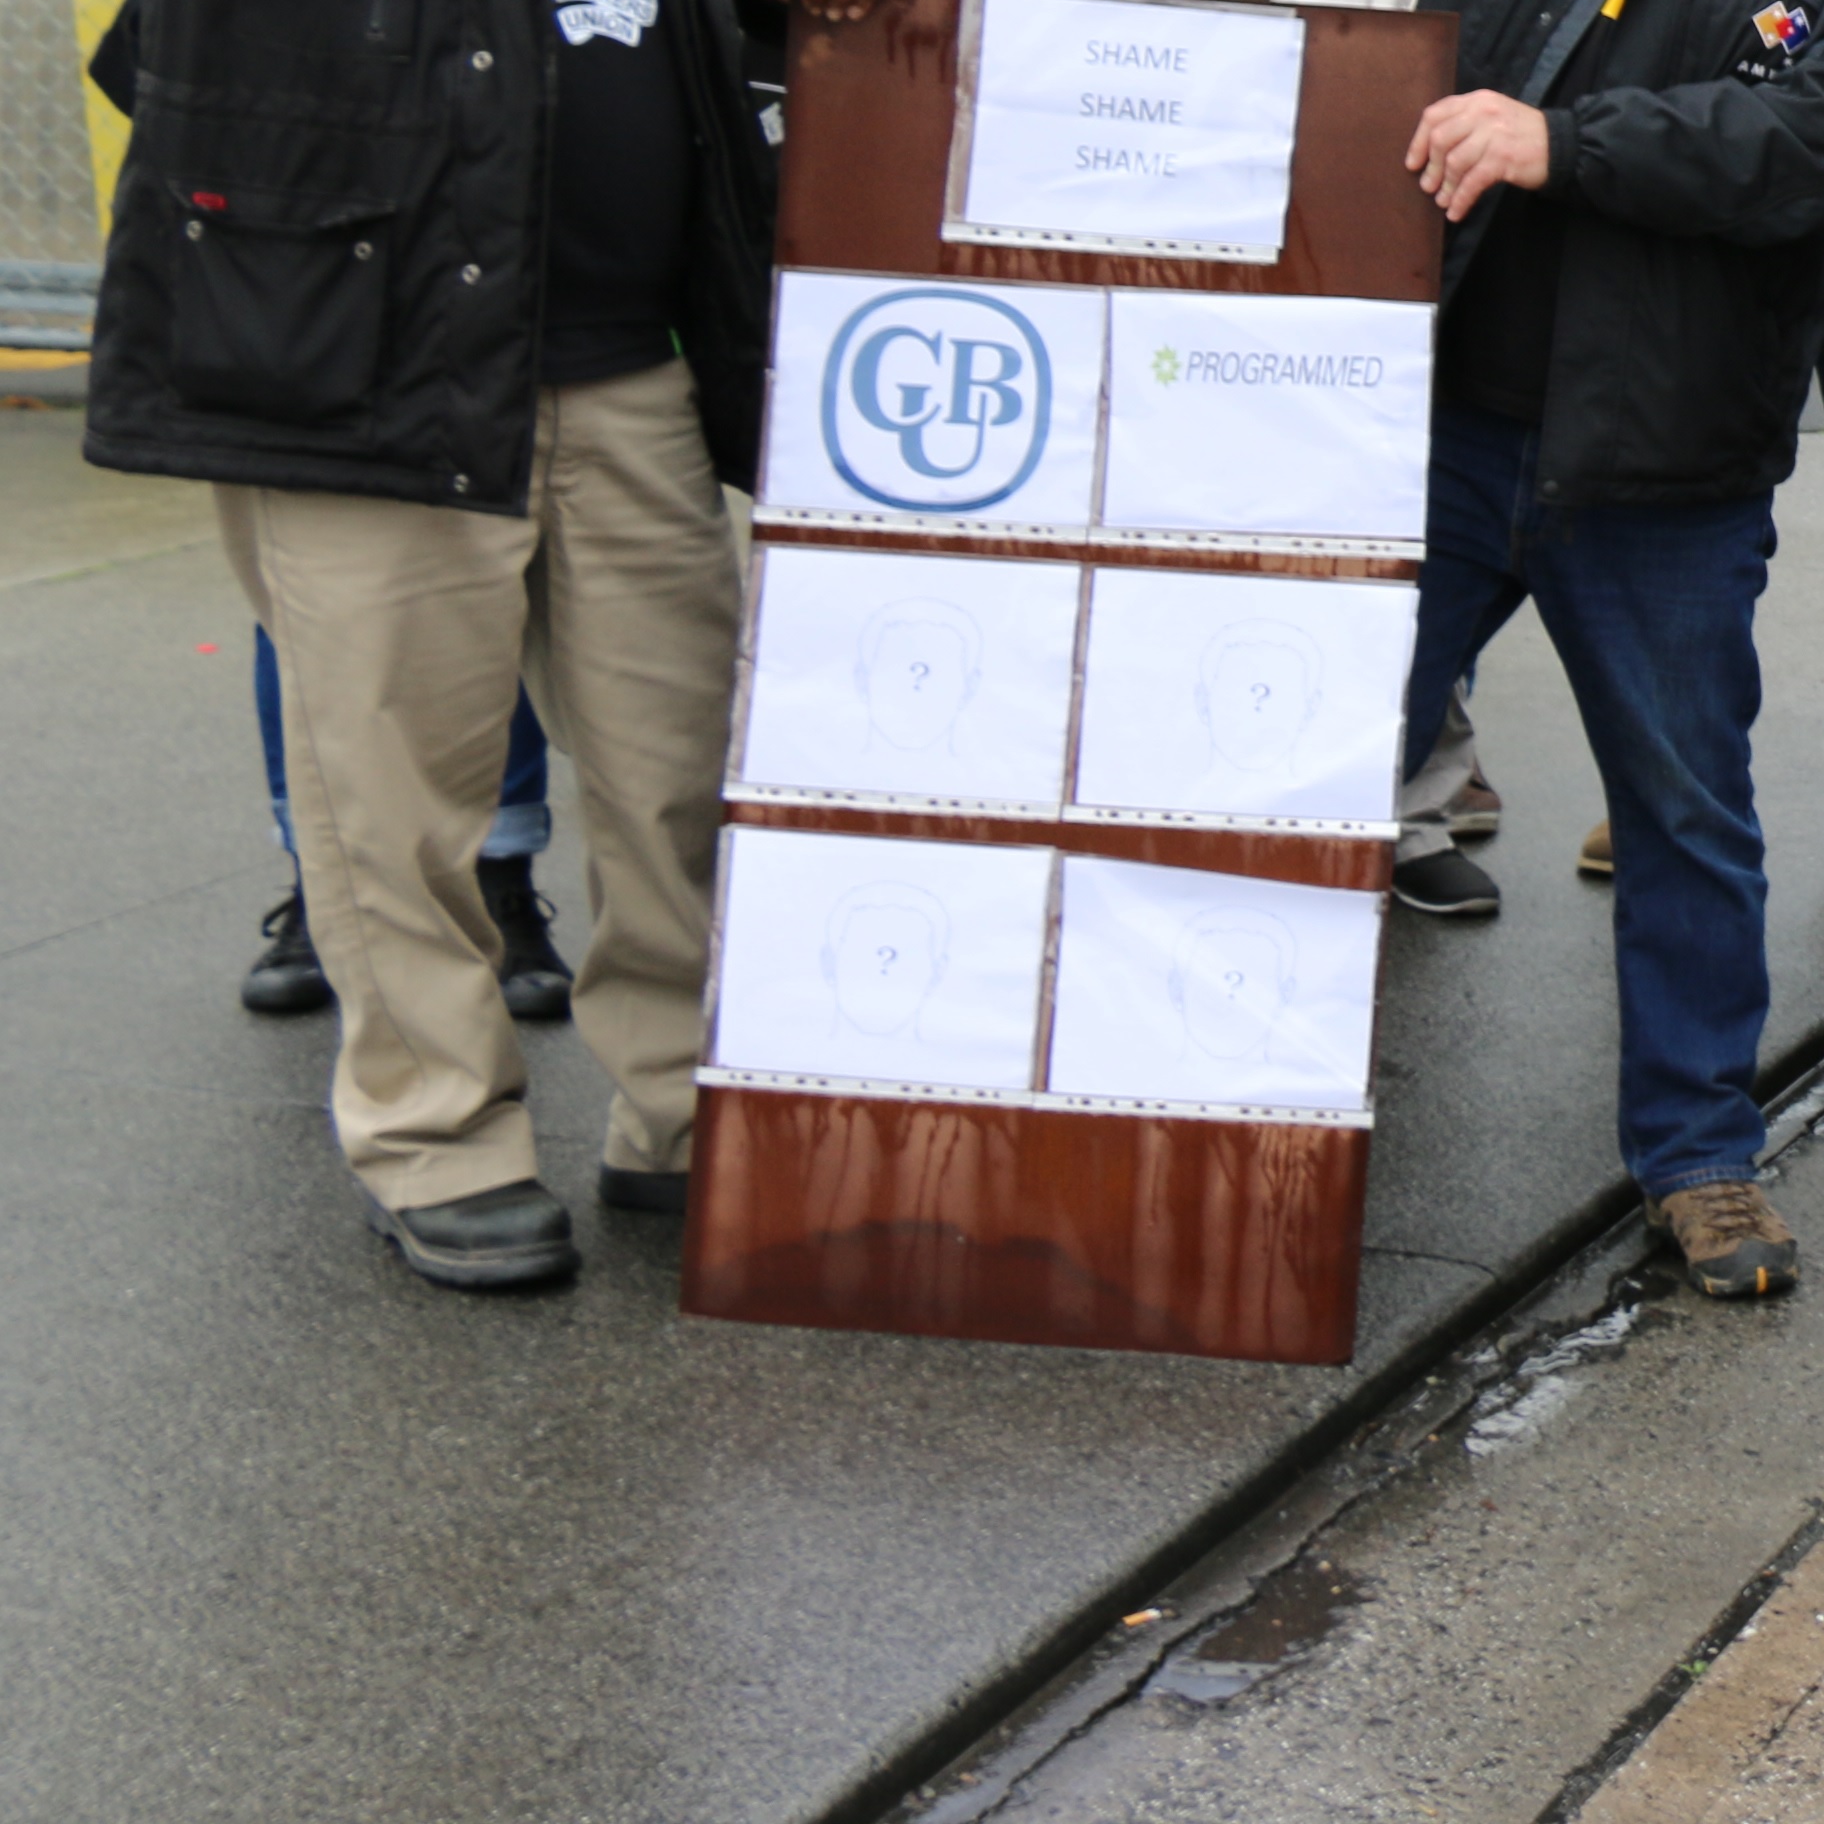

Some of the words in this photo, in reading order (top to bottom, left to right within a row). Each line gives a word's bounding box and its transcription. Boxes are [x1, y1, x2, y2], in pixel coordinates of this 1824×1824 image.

[1084, 39, 1189, 74] SHAME
[1079, 92, 1183, 125] SHAME
[1075, 144, 1178, 178] SHAME
[1186, 349, 1384, 389] PROGRAMMED
